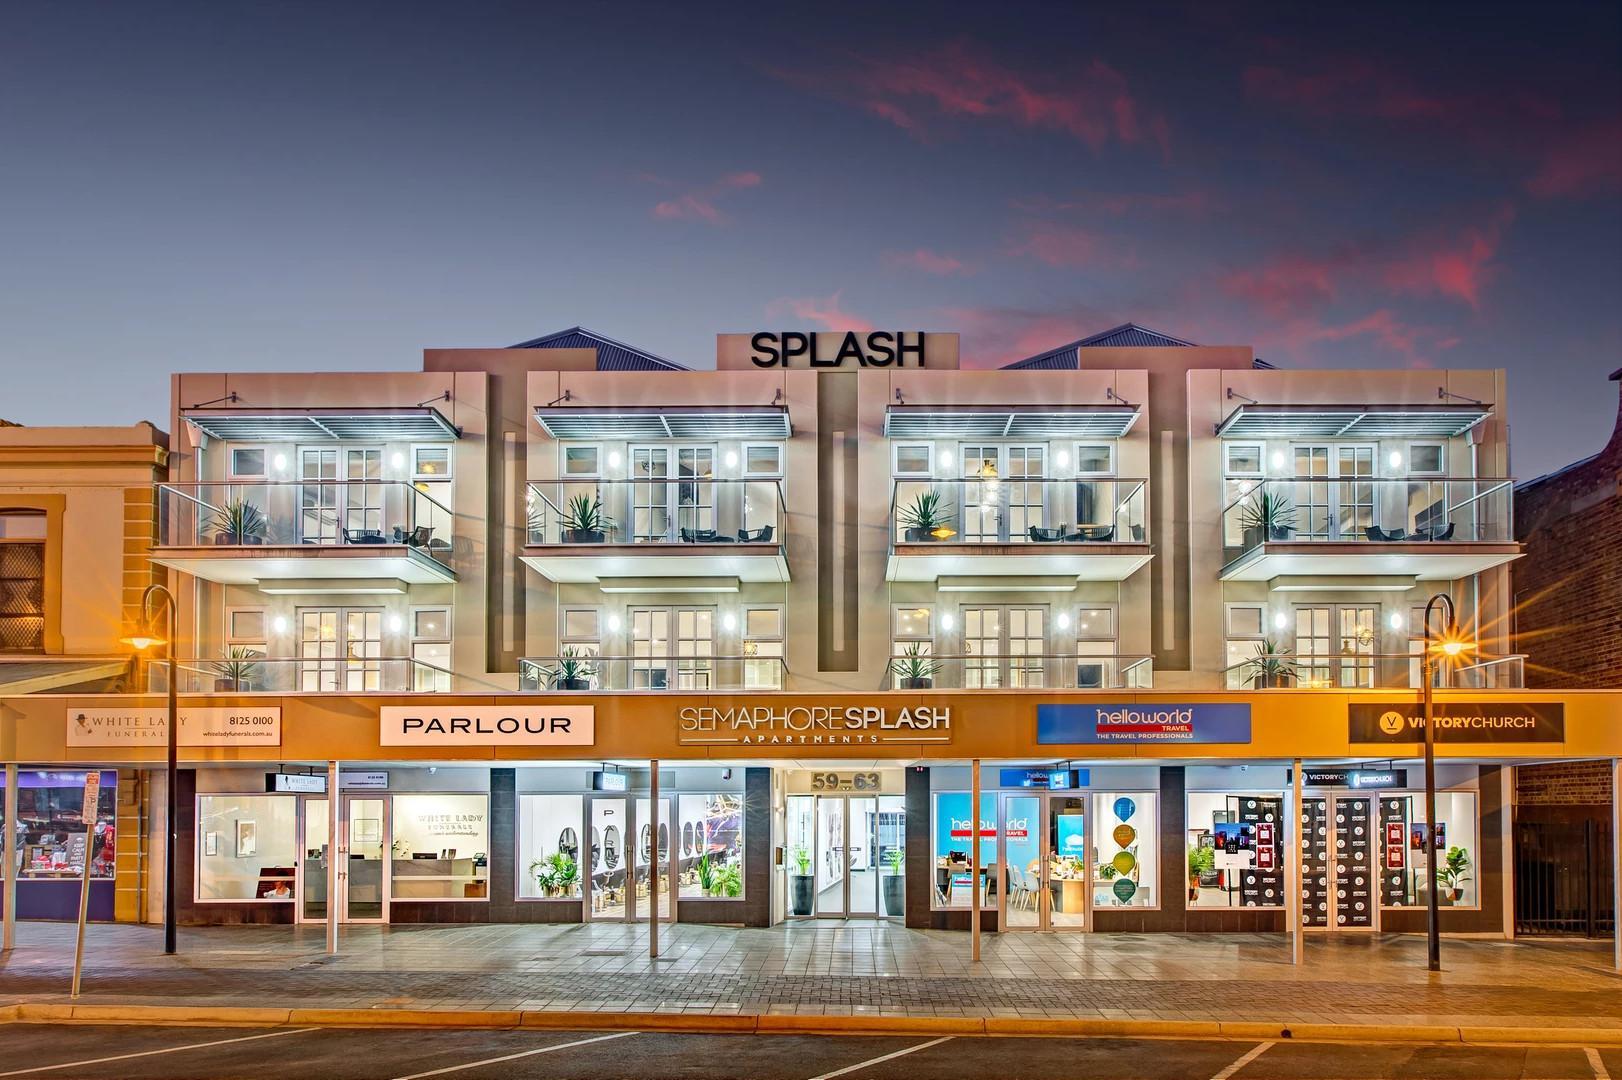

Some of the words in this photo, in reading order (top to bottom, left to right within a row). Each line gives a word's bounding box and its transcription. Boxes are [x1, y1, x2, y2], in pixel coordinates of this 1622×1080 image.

[751, 331, 925, 368] SPLASH
[92, 716, 140, 726] WHITE
[149, 716, 188, 726] LAY
[229, 716, 250, 725] 8125
[252, 716, 273, 725] 0100
[1096, 709, 1193, 724] helloworld
[402, 717, 571, 734] PARLOUR
[743, 735, 878, 743] APARTMENTS
